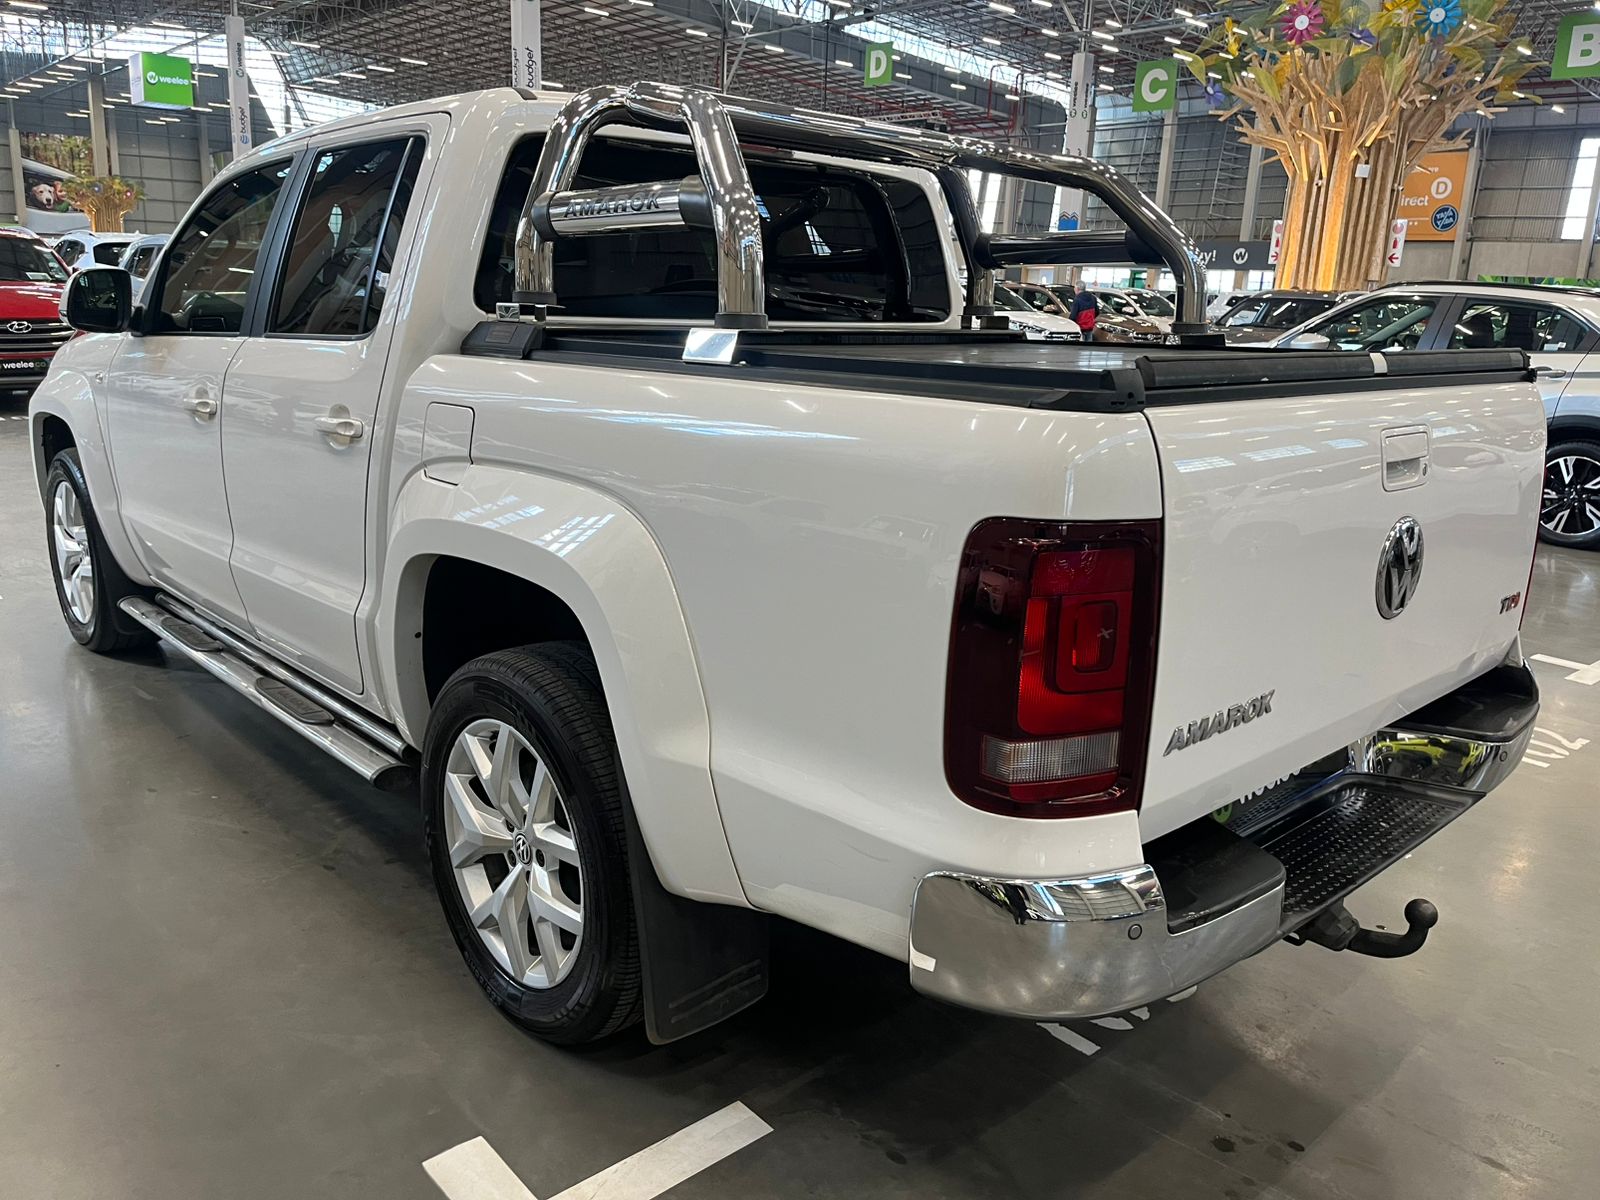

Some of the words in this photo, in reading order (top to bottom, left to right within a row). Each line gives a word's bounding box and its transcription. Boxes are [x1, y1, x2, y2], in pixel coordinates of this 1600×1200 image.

[1566, 23, 1600, 68] B
[525, 45, 537, 89] budget
[869, 49, 887, 79] D
[159, 76, 189, 85] weelee
[1141, 68, 1169, 103] C
[564, 191, 662, 217] AMAROK
[1400, 195, 1429, 206] irect
[2, 361, 34, 369] weelee
[1163, 689, 1275, 757] AMAROK
